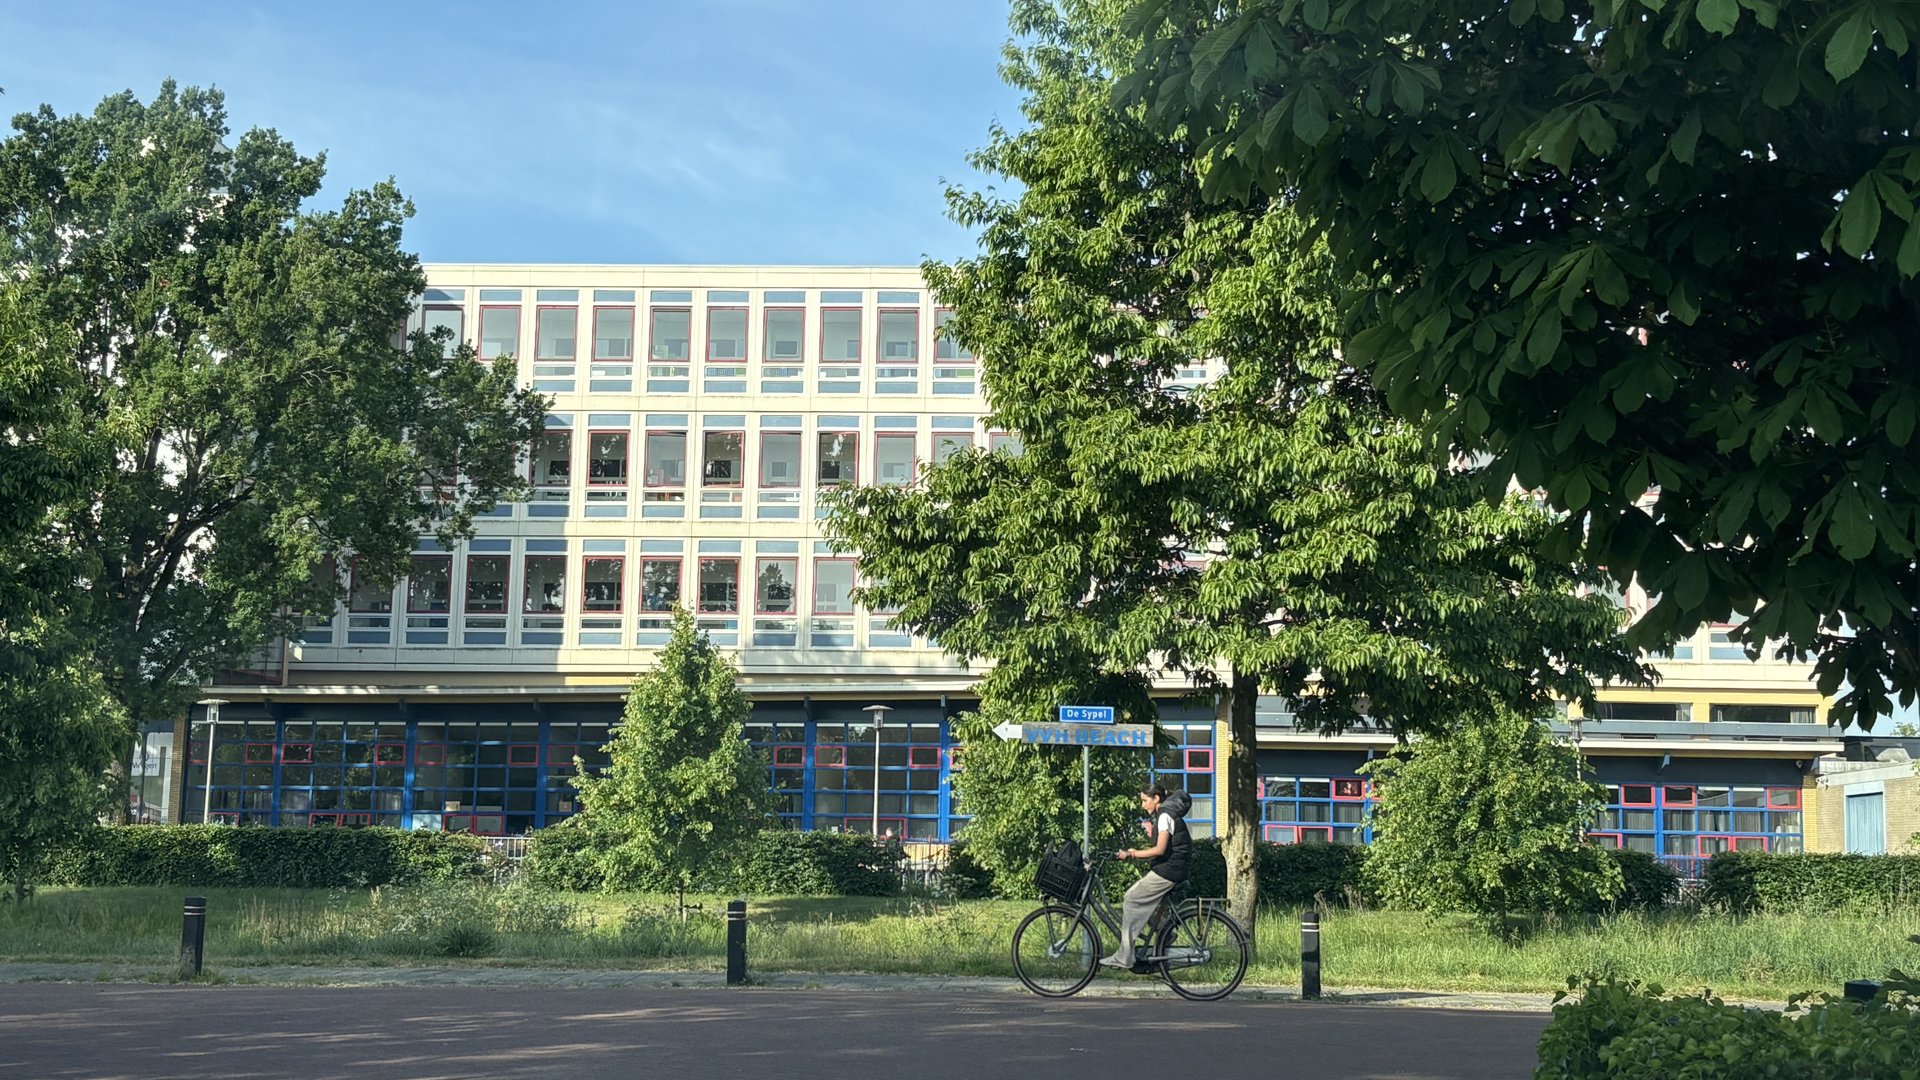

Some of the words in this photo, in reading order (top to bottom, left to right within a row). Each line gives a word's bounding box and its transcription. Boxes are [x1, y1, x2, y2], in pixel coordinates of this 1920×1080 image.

[1066, 709, 1079, 718] De
[1081, 709, 1107, 720] Sypel
[1075, 729, 1147, 746] BEACH
